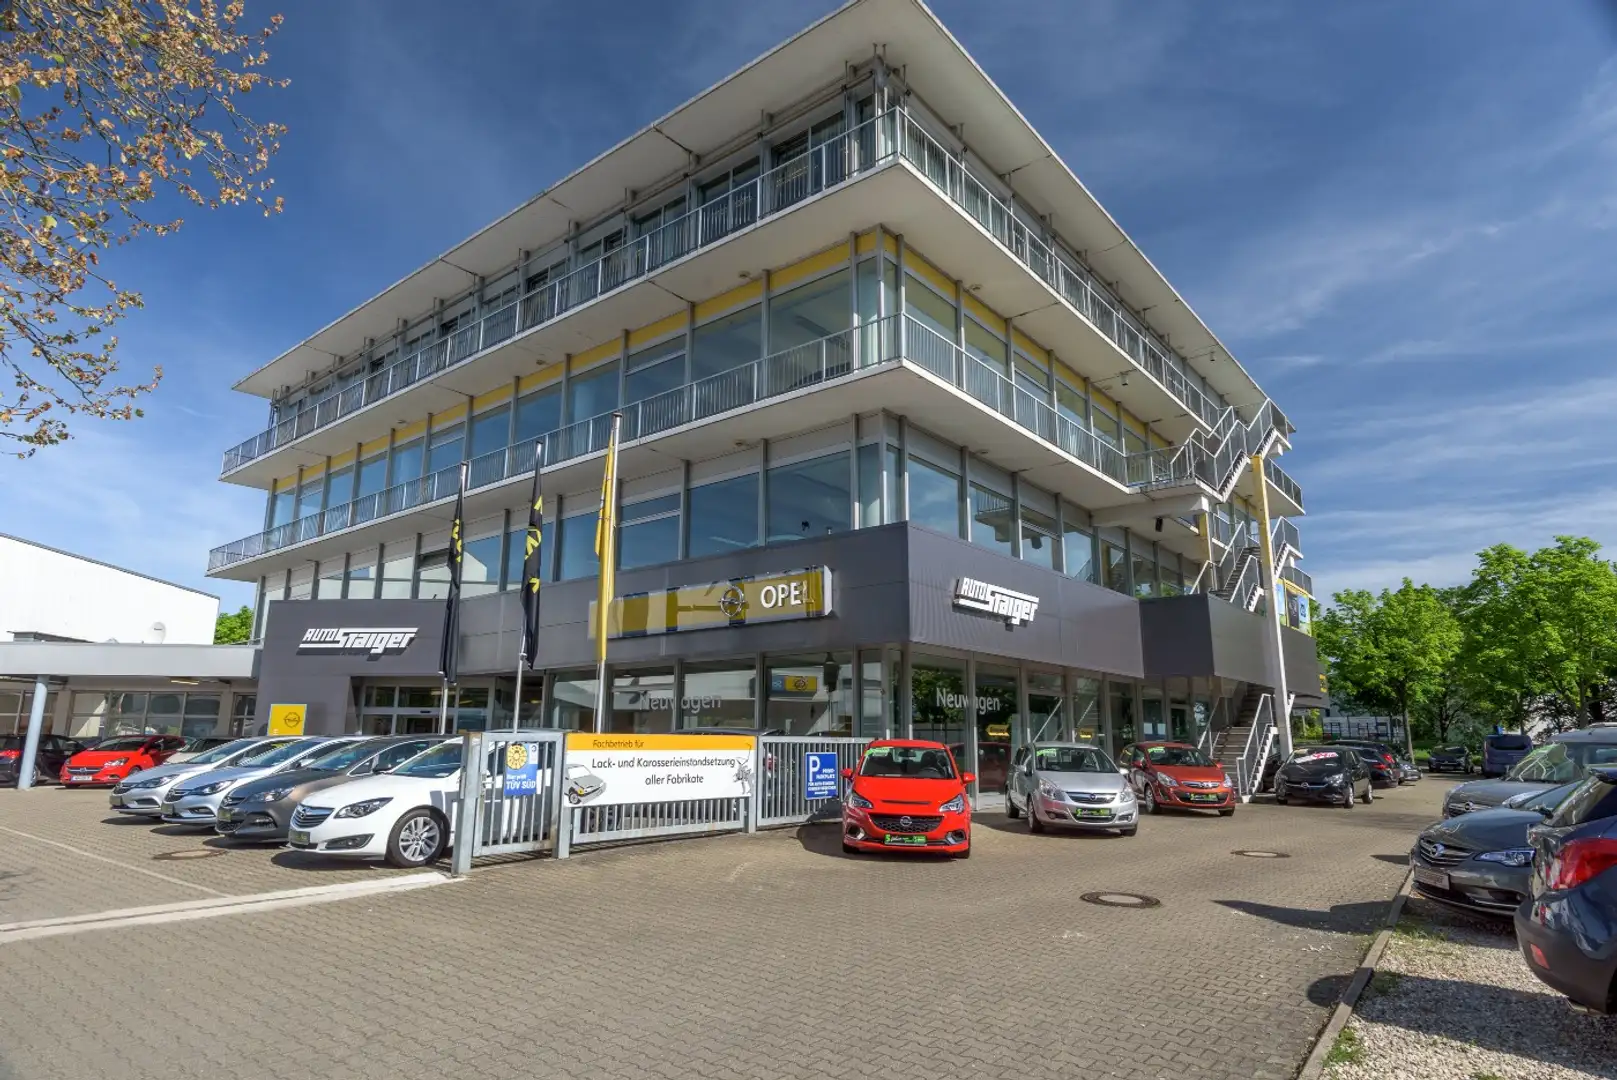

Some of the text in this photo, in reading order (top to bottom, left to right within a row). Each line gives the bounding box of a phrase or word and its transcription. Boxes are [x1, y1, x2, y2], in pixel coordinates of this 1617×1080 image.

[592, 739, 645, 748] Fachbetrieb für
[592, 756, 736, 768] Lack- und Karosserieinstandsetzung
[809, 755, 821, 782] P
[521, 779, 536, 789] SÜD
[645, 772, 704, 785] aller Fabrikate
